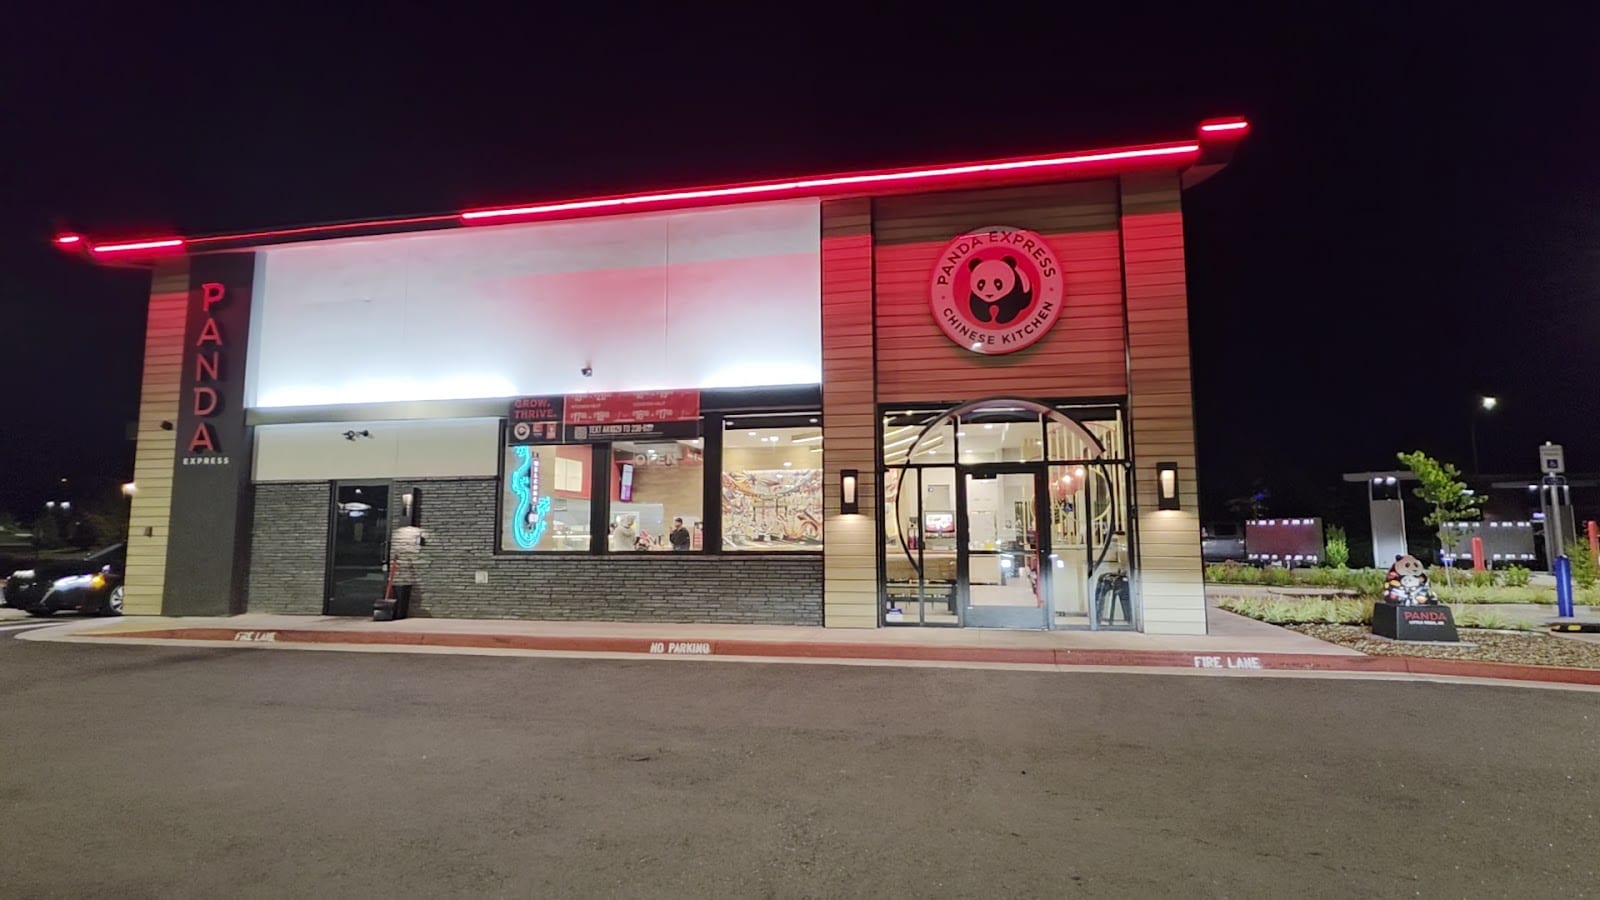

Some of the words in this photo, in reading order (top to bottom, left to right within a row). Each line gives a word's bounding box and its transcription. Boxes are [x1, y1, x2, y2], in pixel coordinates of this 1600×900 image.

[937, 237, 983, 285] PANDA
[989, 231, 1056, 278] EXPRESS
[943, 308, 995, 345] CHINESE
[1002, 301, 1053, 345] KITCHEN
[188, 282, 226, 452] PANDA
[182, 456, 230, 466] EXPRESS
[1403, 611, 1448, 621] PANDA
[650, 642, 665, 654] NO
[668, 642, 710, 654] PARKING
[1193, 655, 1223, 668] FIRE
[1226, 656, 1263, 669] LANE
